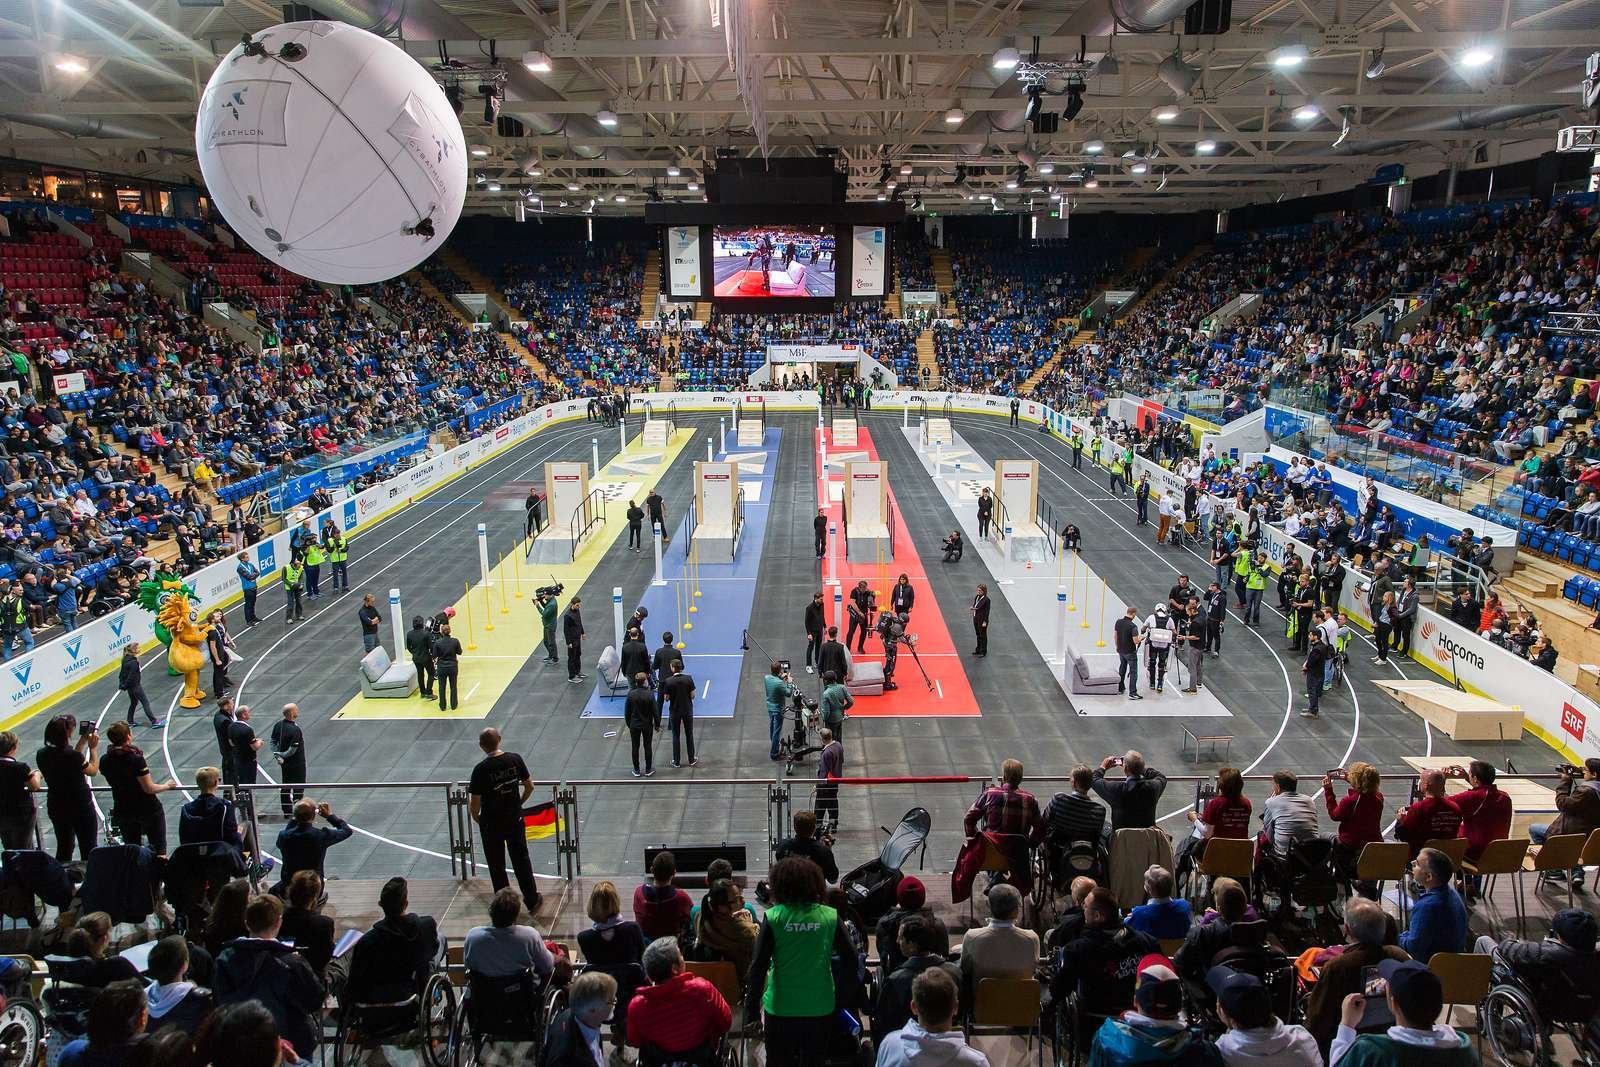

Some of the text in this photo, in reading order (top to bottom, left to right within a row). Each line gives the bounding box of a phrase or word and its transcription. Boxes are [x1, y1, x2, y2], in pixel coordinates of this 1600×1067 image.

[1162, 475, 1184, 492] CYBATHLO
[345, 513, 357, 526] EKZ
[260, 556, 275, 571] EKZ
[107, 635, 132, 650] VAMED
[1438, 631, 1486, 671] Hocoma
[63, 657, 90, 675] VAMED
[11, 682, 42, 702] VAMED
[1564, 710, 1584, 733] SRF
[785, 922, 822, 932] STAFF
